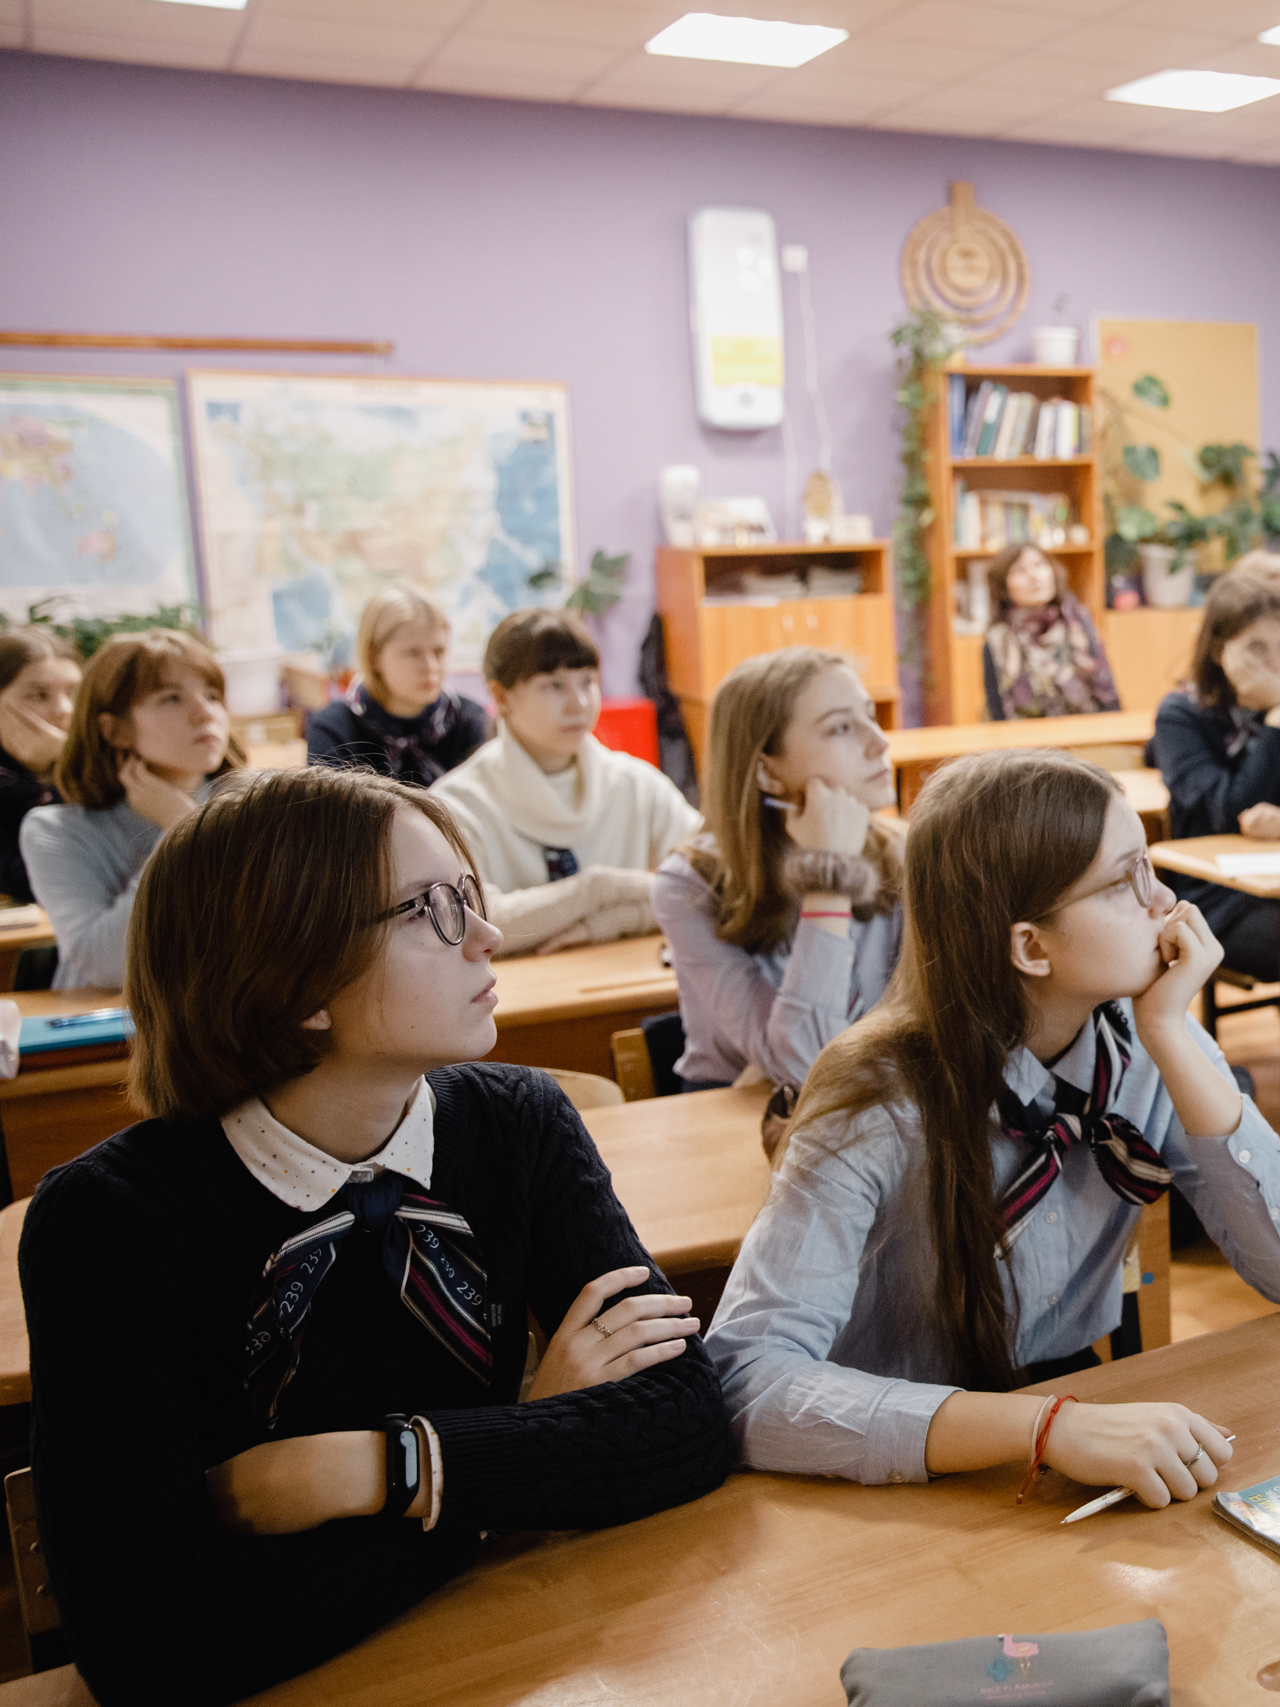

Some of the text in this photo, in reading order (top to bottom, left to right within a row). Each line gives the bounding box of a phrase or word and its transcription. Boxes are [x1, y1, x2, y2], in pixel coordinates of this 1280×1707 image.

[415, 1224, 440, 1249] 239
[440, 1253, 455, 1278] 239
[279, 1281, 304, 1314] 239
[456, 1281, 483, 1306] 239
